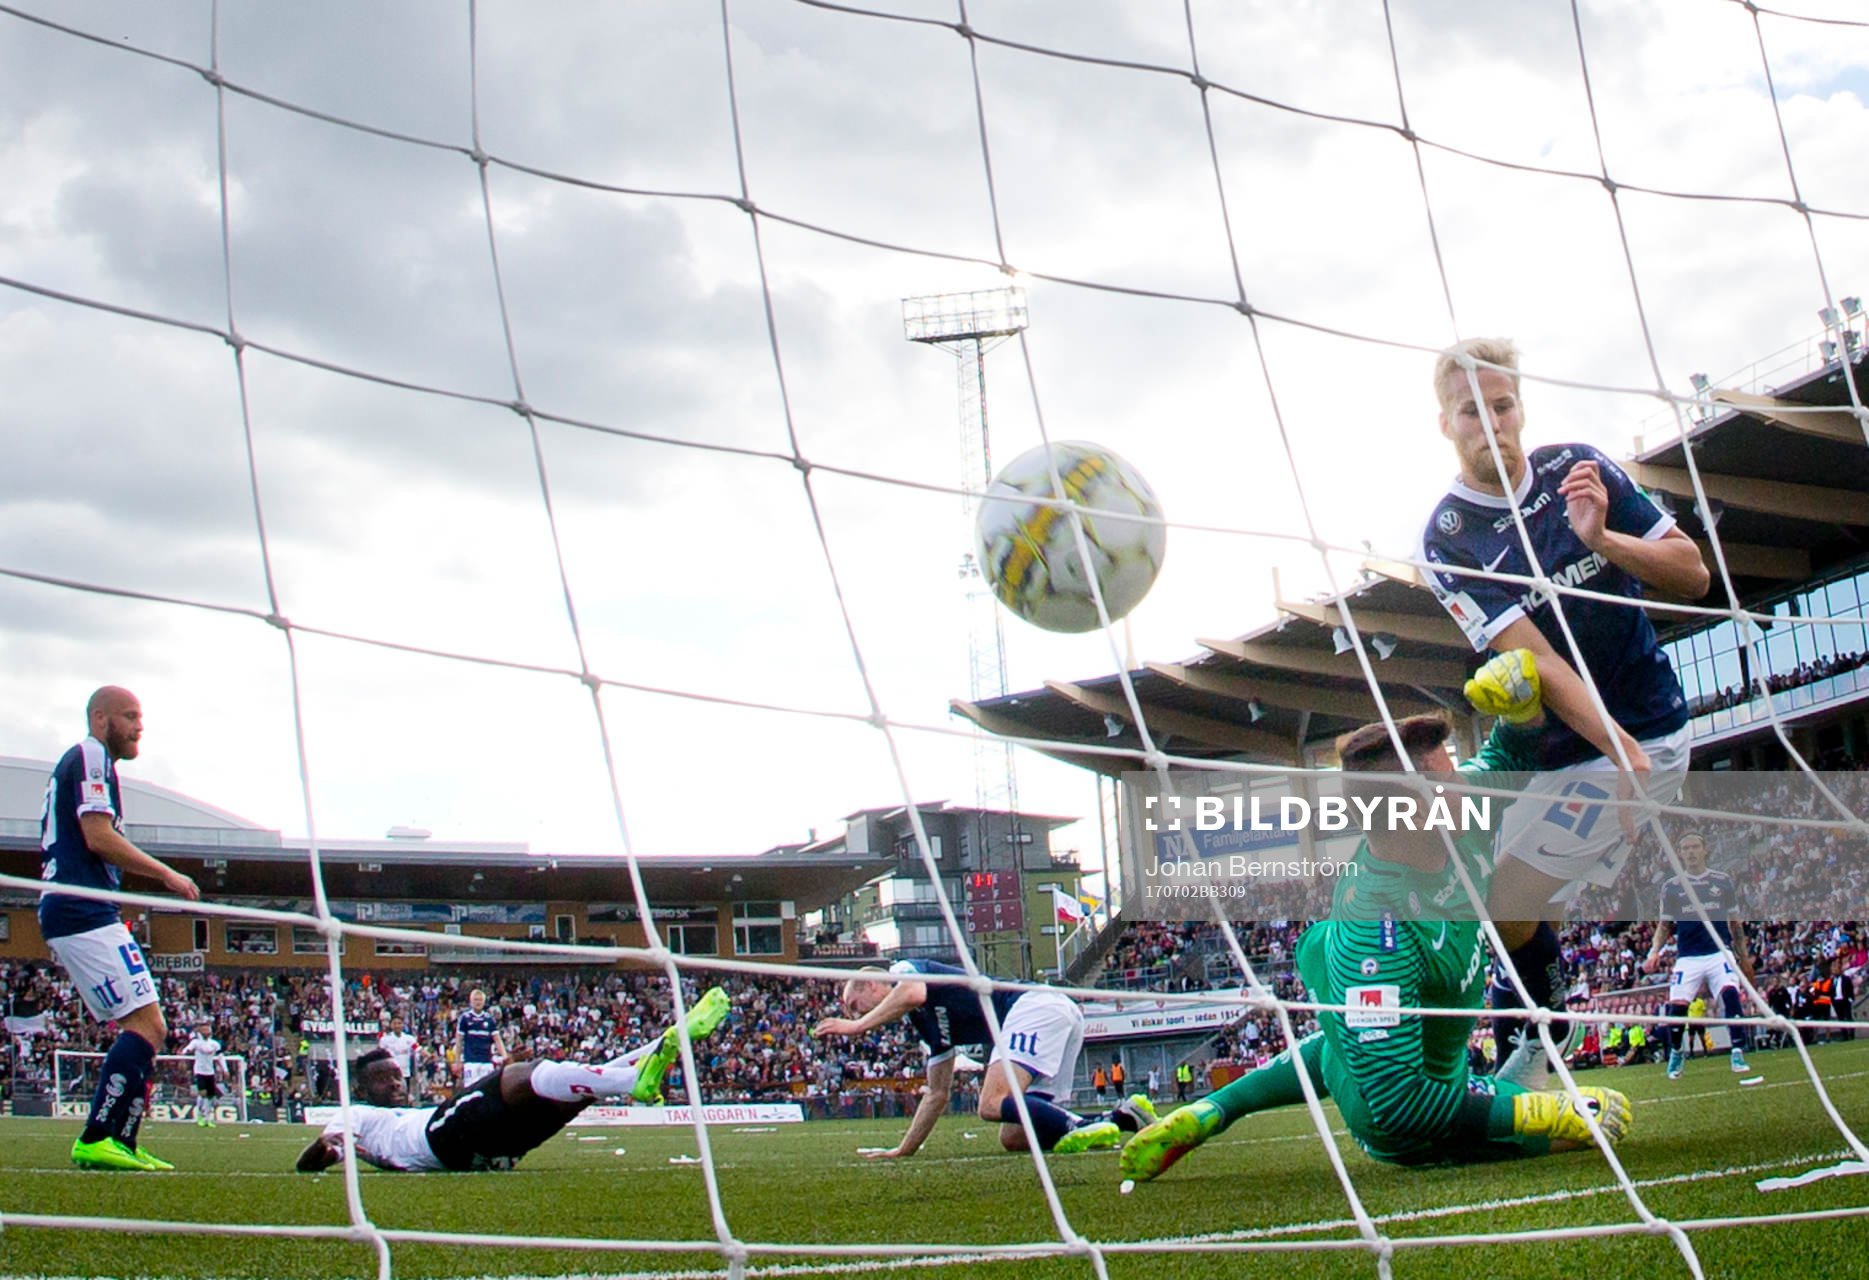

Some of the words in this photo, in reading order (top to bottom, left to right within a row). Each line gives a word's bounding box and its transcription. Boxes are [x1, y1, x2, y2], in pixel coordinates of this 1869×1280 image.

[1493, 492, 1551, 534] Staium
[1520, 552, 1608, 612] HOMEN
[91, 975, 124, 1009] nt
[131, 977, 152, 998] 20
[302, 1020, 380, 1034] EYRAALLEN
[1009, 1031, 1040, 1057] nt
[150, 1104, 238, 1122] BYG
[665, 1107, 758, 1122] TAKGGAR'N
